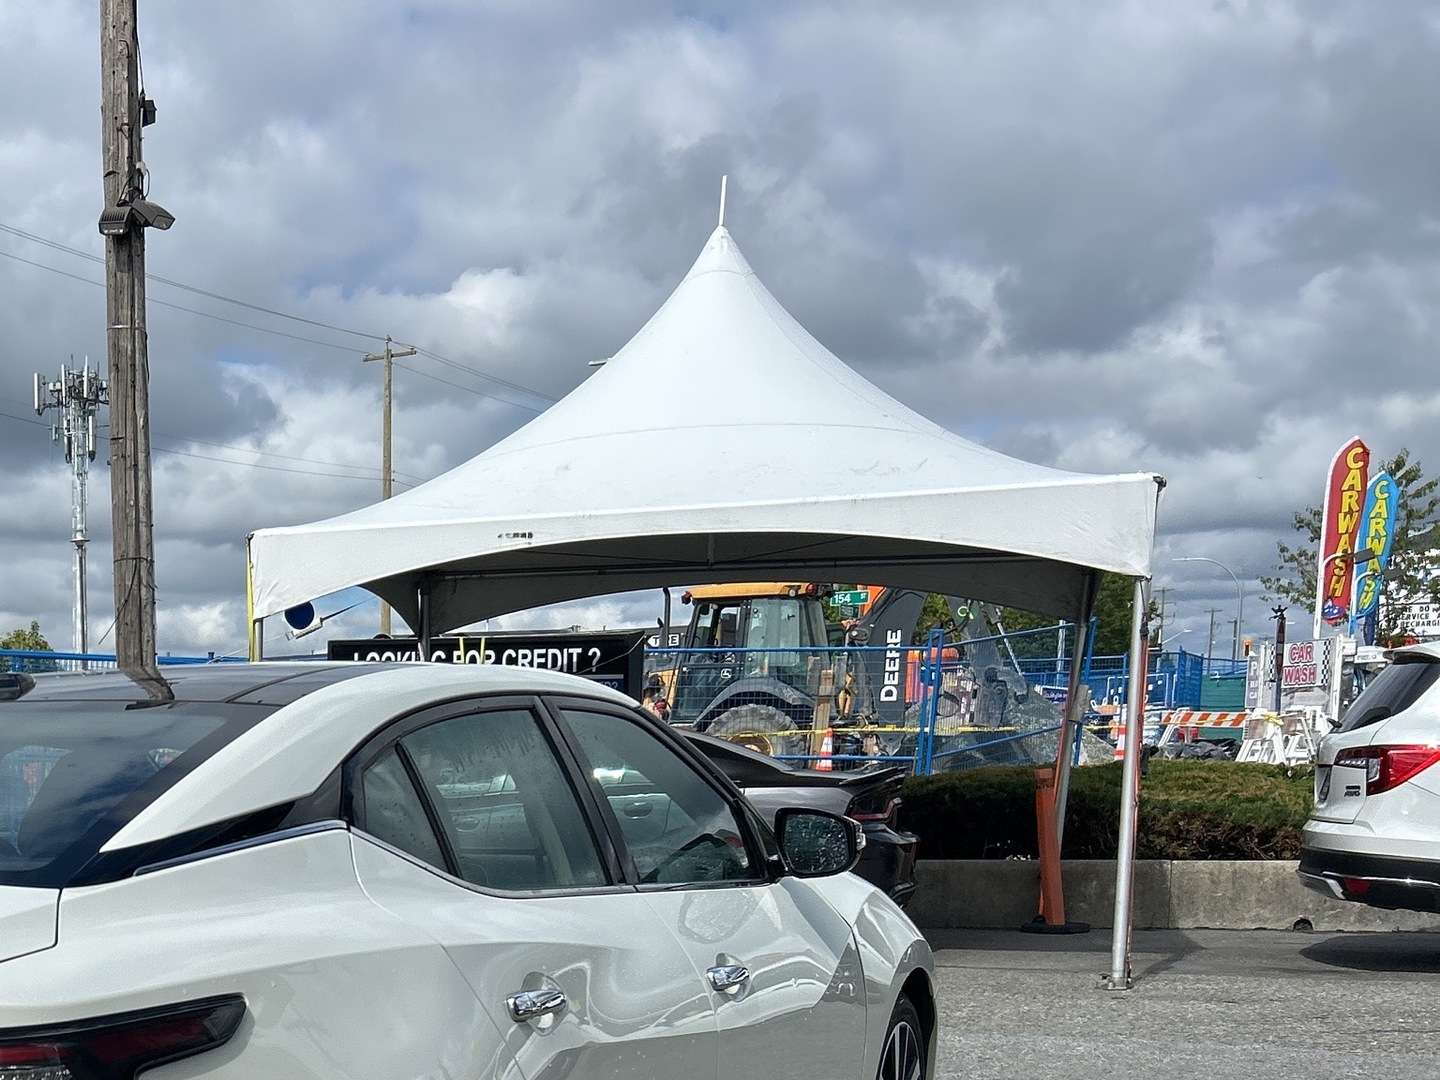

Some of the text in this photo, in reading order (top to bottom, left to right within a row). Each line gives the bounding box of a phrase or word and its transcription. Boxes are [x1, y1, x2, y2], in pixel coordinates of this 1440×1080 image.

[502, 648, 582, 673] CREDIT
[1289, 643, 1315, 663] CAR
[880, 629, 902, 702] DEERE
[1283, 664, 1318, 686] WASH
